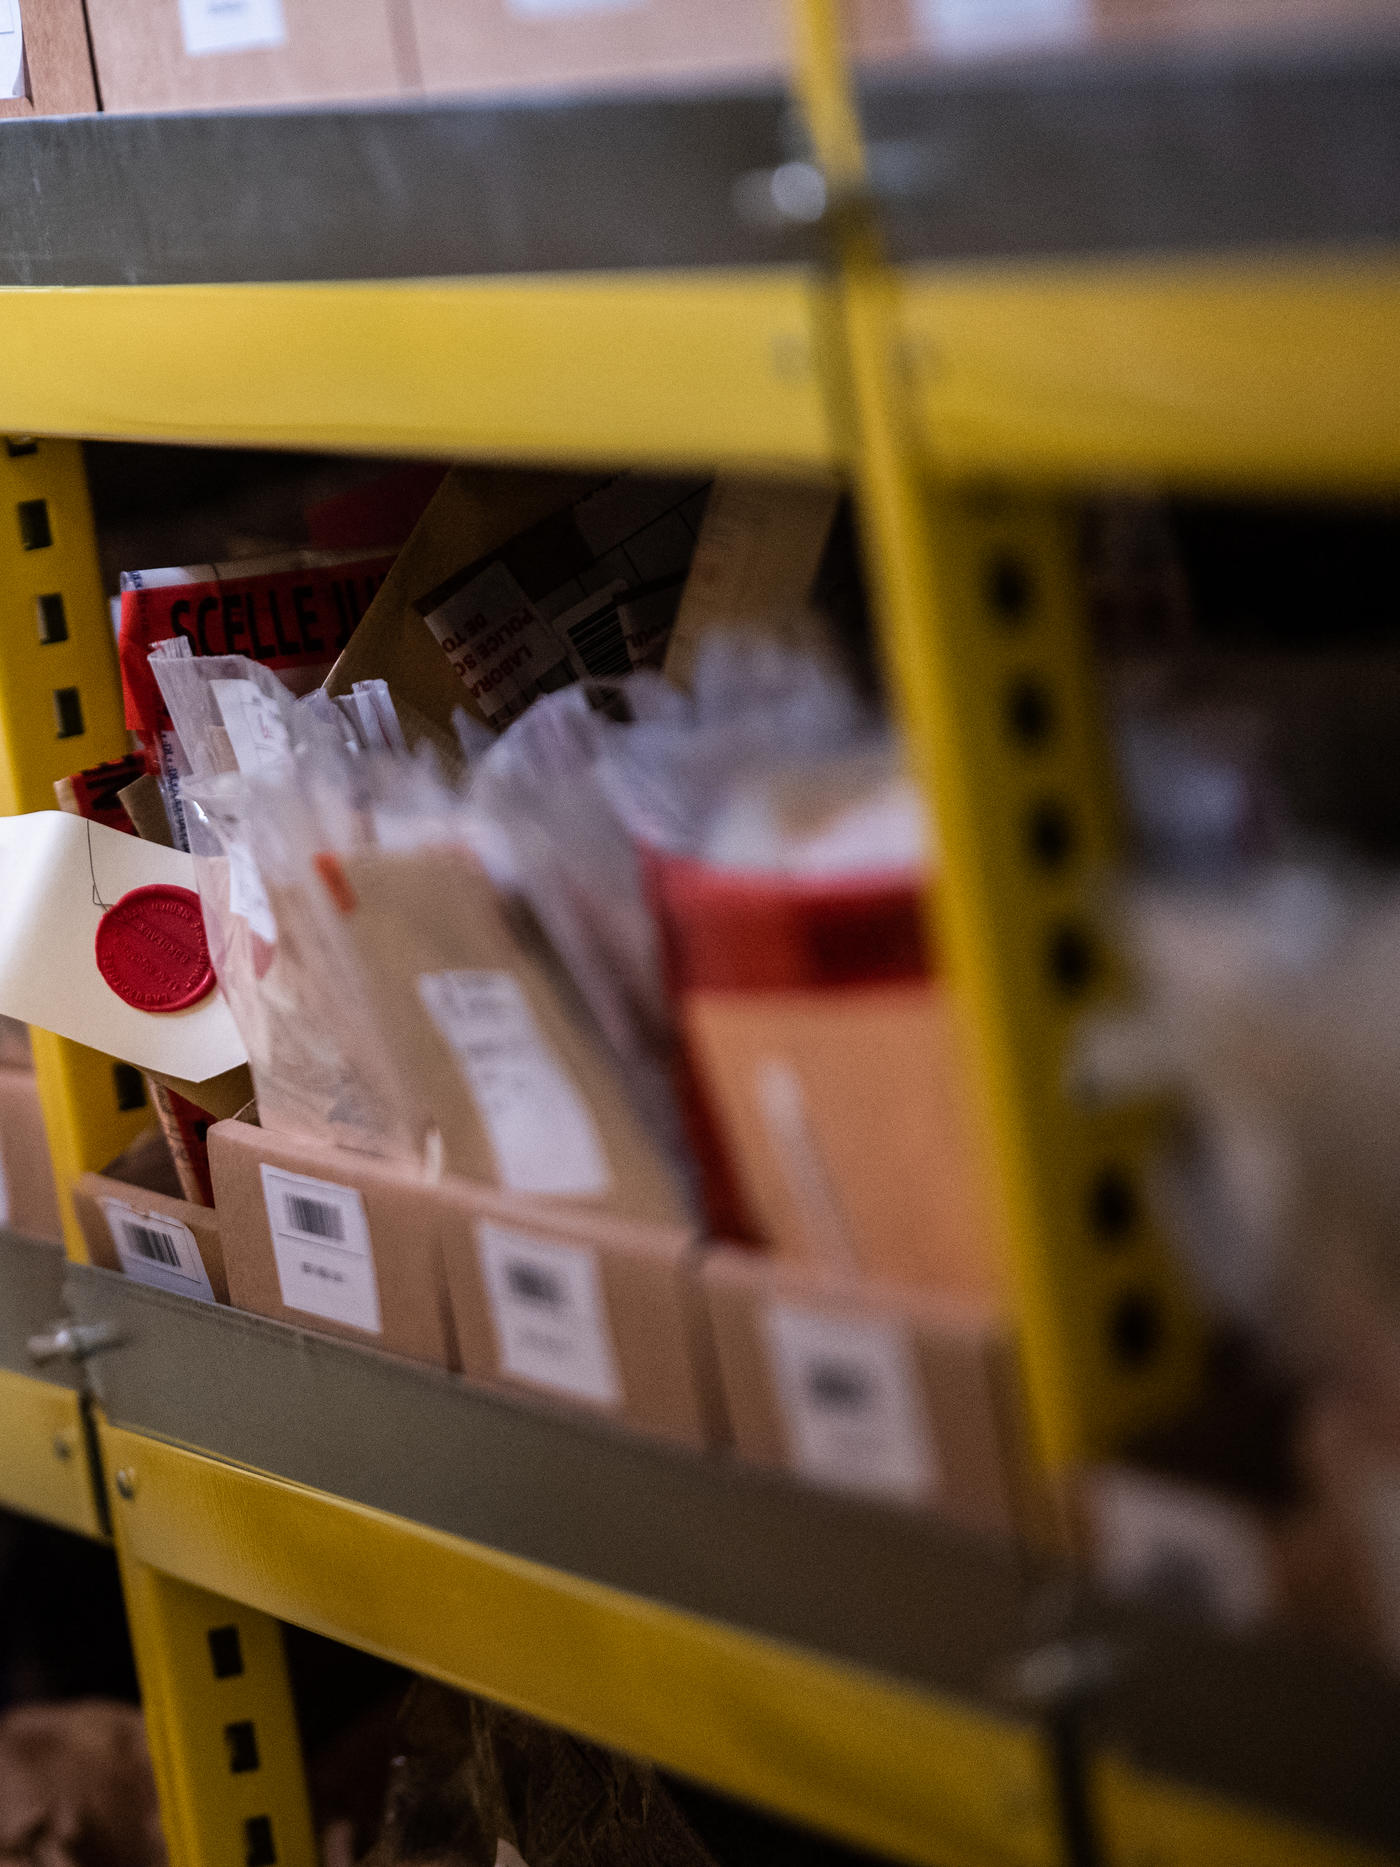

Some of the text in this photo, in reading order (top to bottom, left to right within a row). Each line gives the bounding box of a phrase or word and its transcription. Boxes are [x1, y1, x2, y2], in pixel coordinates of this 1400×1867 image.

[171, 572, 387, 660] SCELLE JU
[464, 612, 488, 636] DE
[476, 606, 536, 660] POLICE
